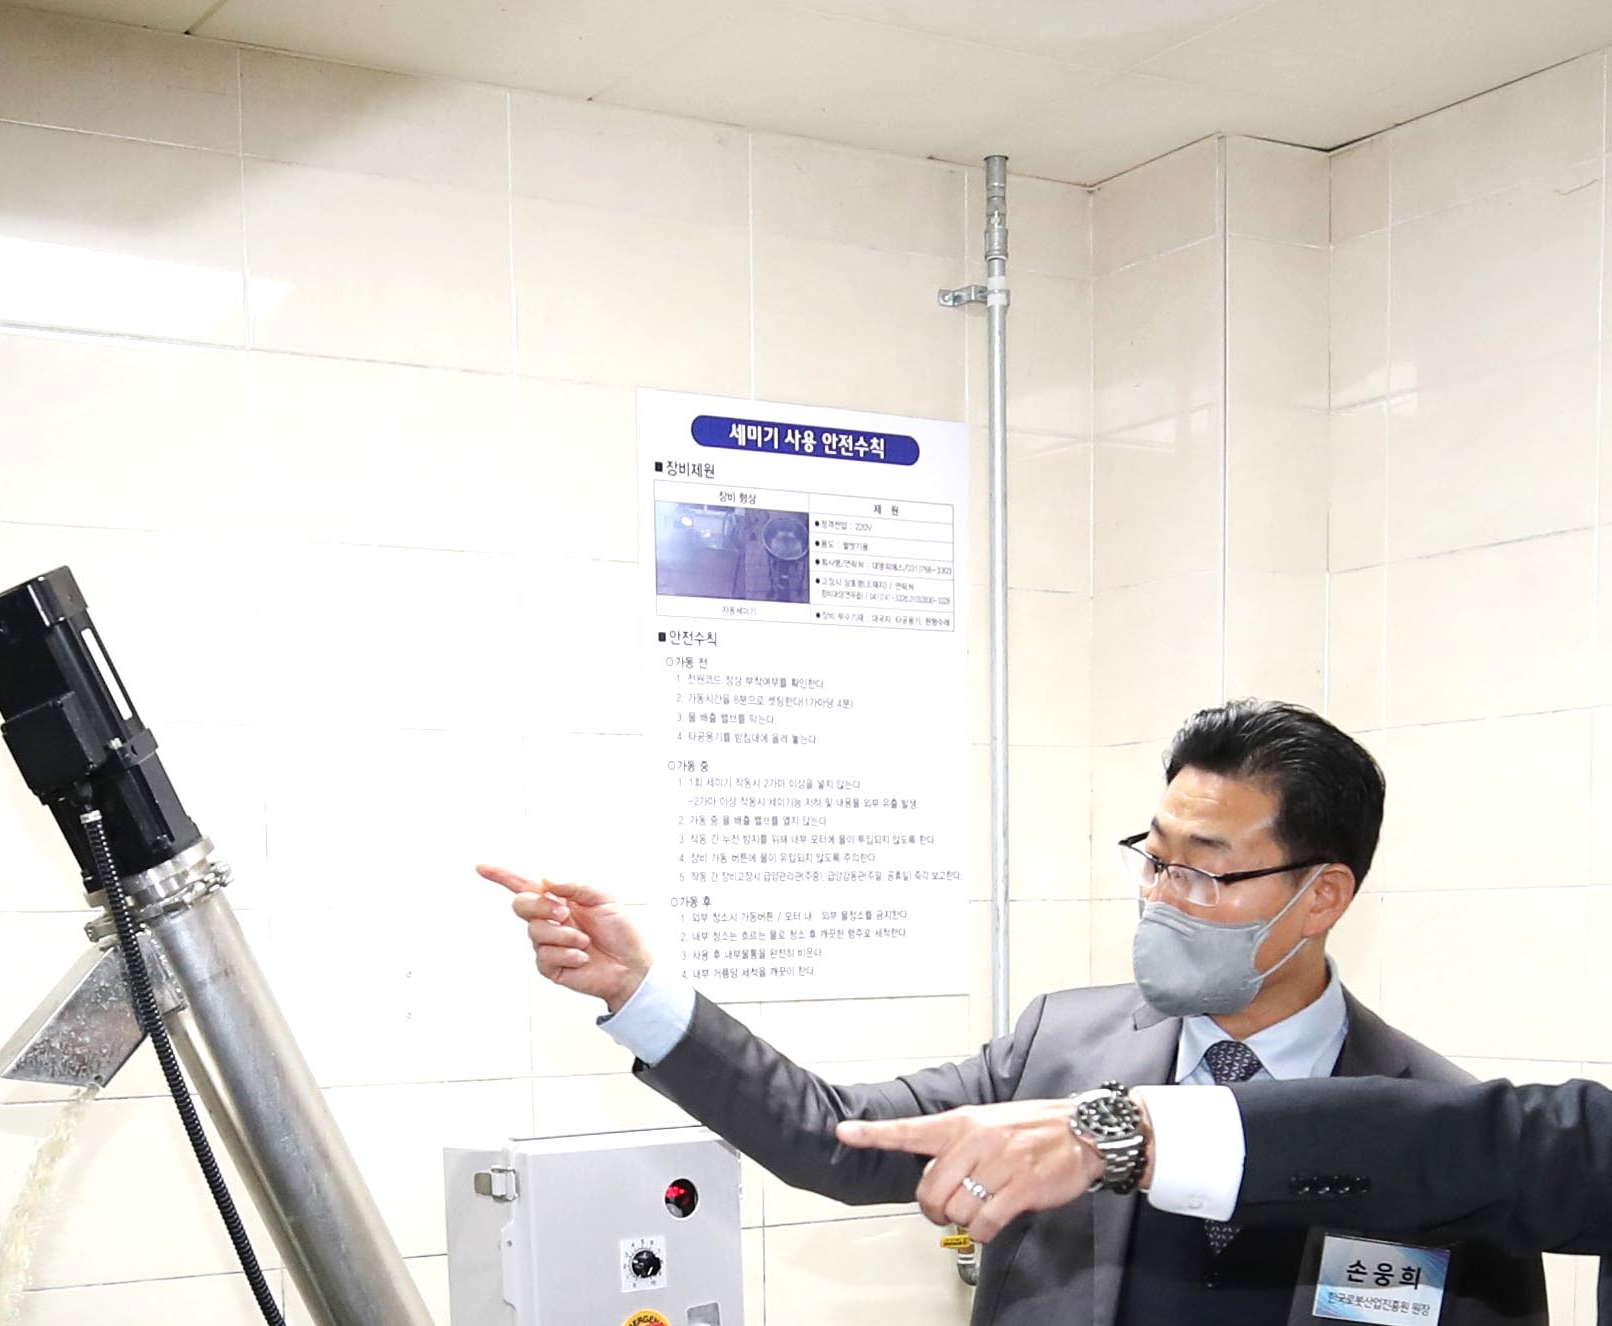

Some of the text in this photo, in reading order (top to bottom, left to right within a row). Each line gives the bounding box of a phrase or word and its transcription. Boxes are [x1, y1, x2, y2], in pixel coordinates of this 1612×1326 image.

[729, 423, 885, 459] 세미기 사용 안전수칙
[666, 461, 714, 479] 장비제원
[719, 491, 735, 502] 장비
[669, 630, 717, 646] 안전수칙
[678, 760, 695, 772] 가동
[680, 896, 698, 908] 가동
[1328, 1292, 1409, 1313] 한국로봇산업진흥원
